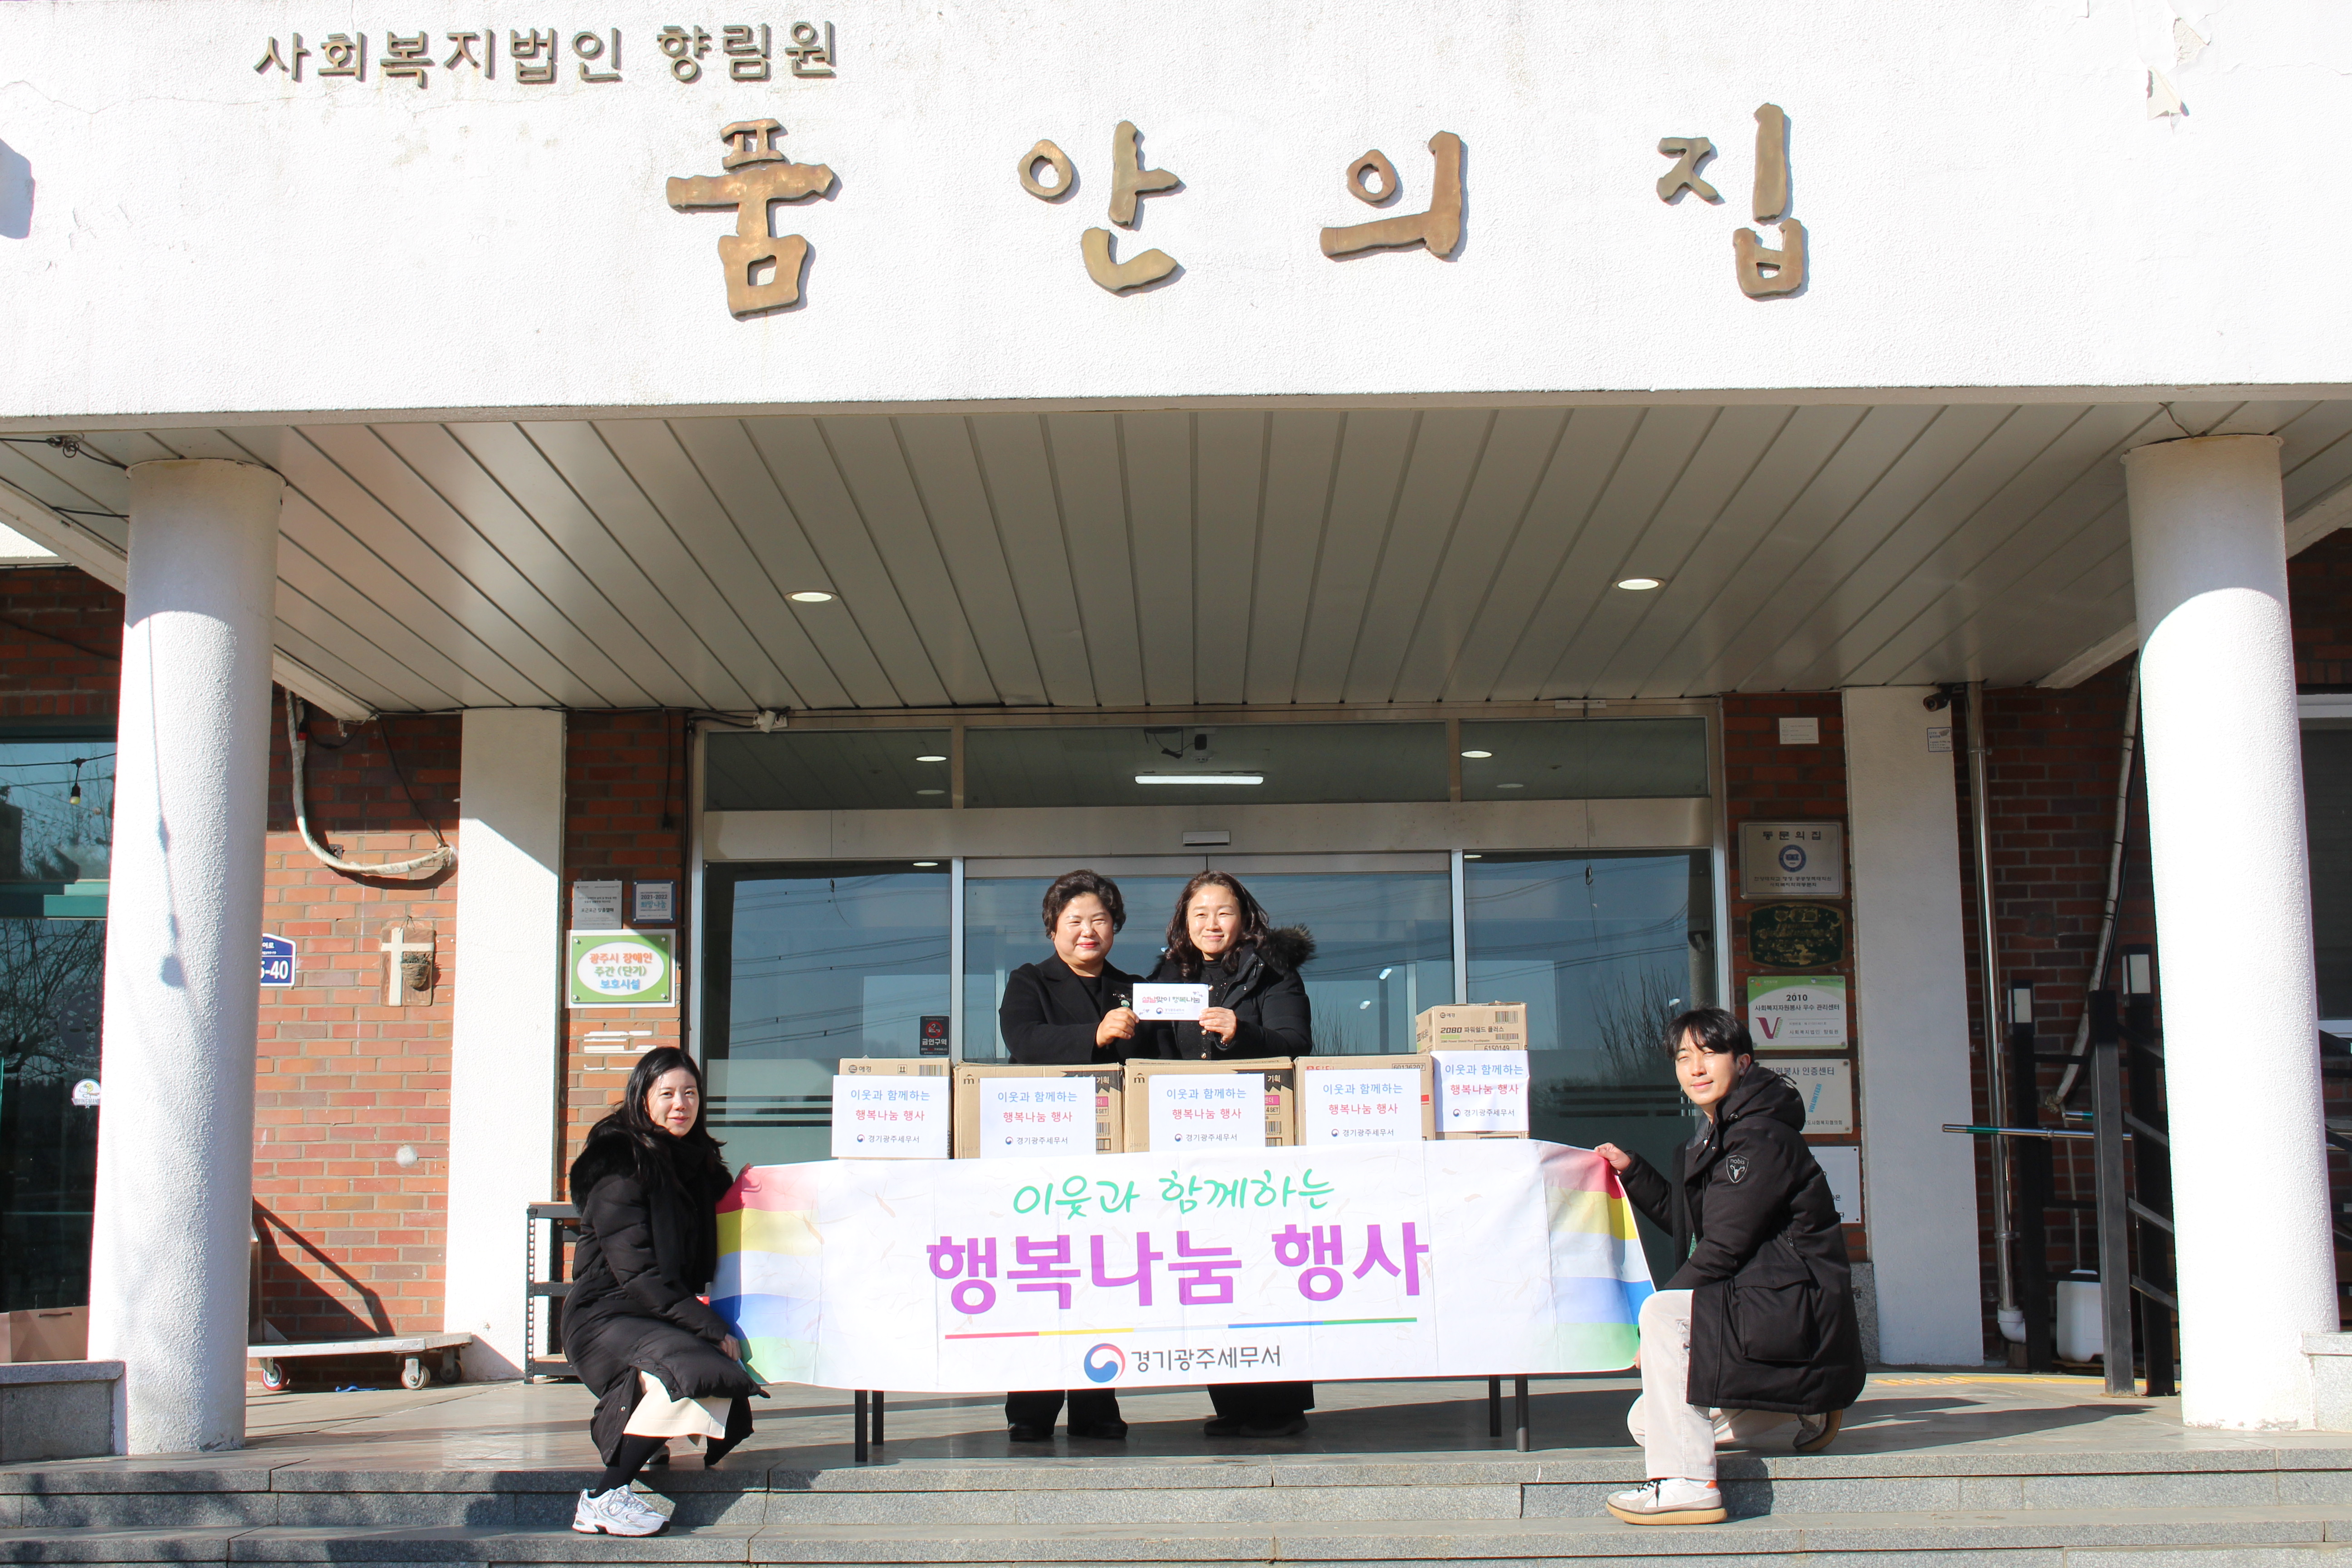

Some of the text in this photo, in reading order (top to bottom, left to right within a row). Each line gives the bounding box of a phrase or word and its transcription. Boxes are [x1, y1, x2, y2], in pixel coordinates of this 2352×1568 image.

[253, 21, 838, 88] 사회복지법인 향림원
[666, 118, 838, 318] 품
[1657, 103, 1807, 298] 집
[641, 900, 666, 909] 희망나눔
[589, 952, 653, 964] 광주시 장애인
[594, 966, 647, 977] 주간 (단기)
[600, 979, 640, 990] 보호시설
[1446, 1064, 1524, 1076] 이웃과 함께하는
[1803, 1067, 1834, 1076] 인증센터
[1096, 1076, 1110, 1084] 기획
[1267, 1074, 1281, 1083] 기획
[1167, 1088, 1247, 1100] 이웃과 함께하는
[1323, 1083, 1403, 1095] 이웃과 함께하는
[1450, 1084, 1519, 1096] 행복나눔 행사
[851, 1090, 931, 1102] 이웃과 함께하는
[998, 1092, 1078, 1103] 이웃과 함께하는
[1808, 1083, 1822, 1113] VOLUNTEER
[1172, 1108, 1242, 1120] 행복나눔 행사
[1328, 1103, 1398, 1116] 행복나눔 행사
[1465, 1109, 1515, 1117] 경기광주세무서
[856, 1110, 926, 1122] 행복나눔 행사
[1003, 1112, 1073, 1123] 행복나눔 행사
[868, 1135, 920, 1143] 경기광주세무서
[1186, 1134, 1237, 1142] 경기광주세무서
[1343, 1129, 1394, 1137] 경기광주세무서
[1017, 1137, 1068, 1145] 경기광주세무서
[1013, 1168, 1335, 1220] 이웃과 함께하는
[926, 1221, 1429, 1315] 행복나눔 행사
[1131, 1345, 1281, 1372] 경기광주세무서
